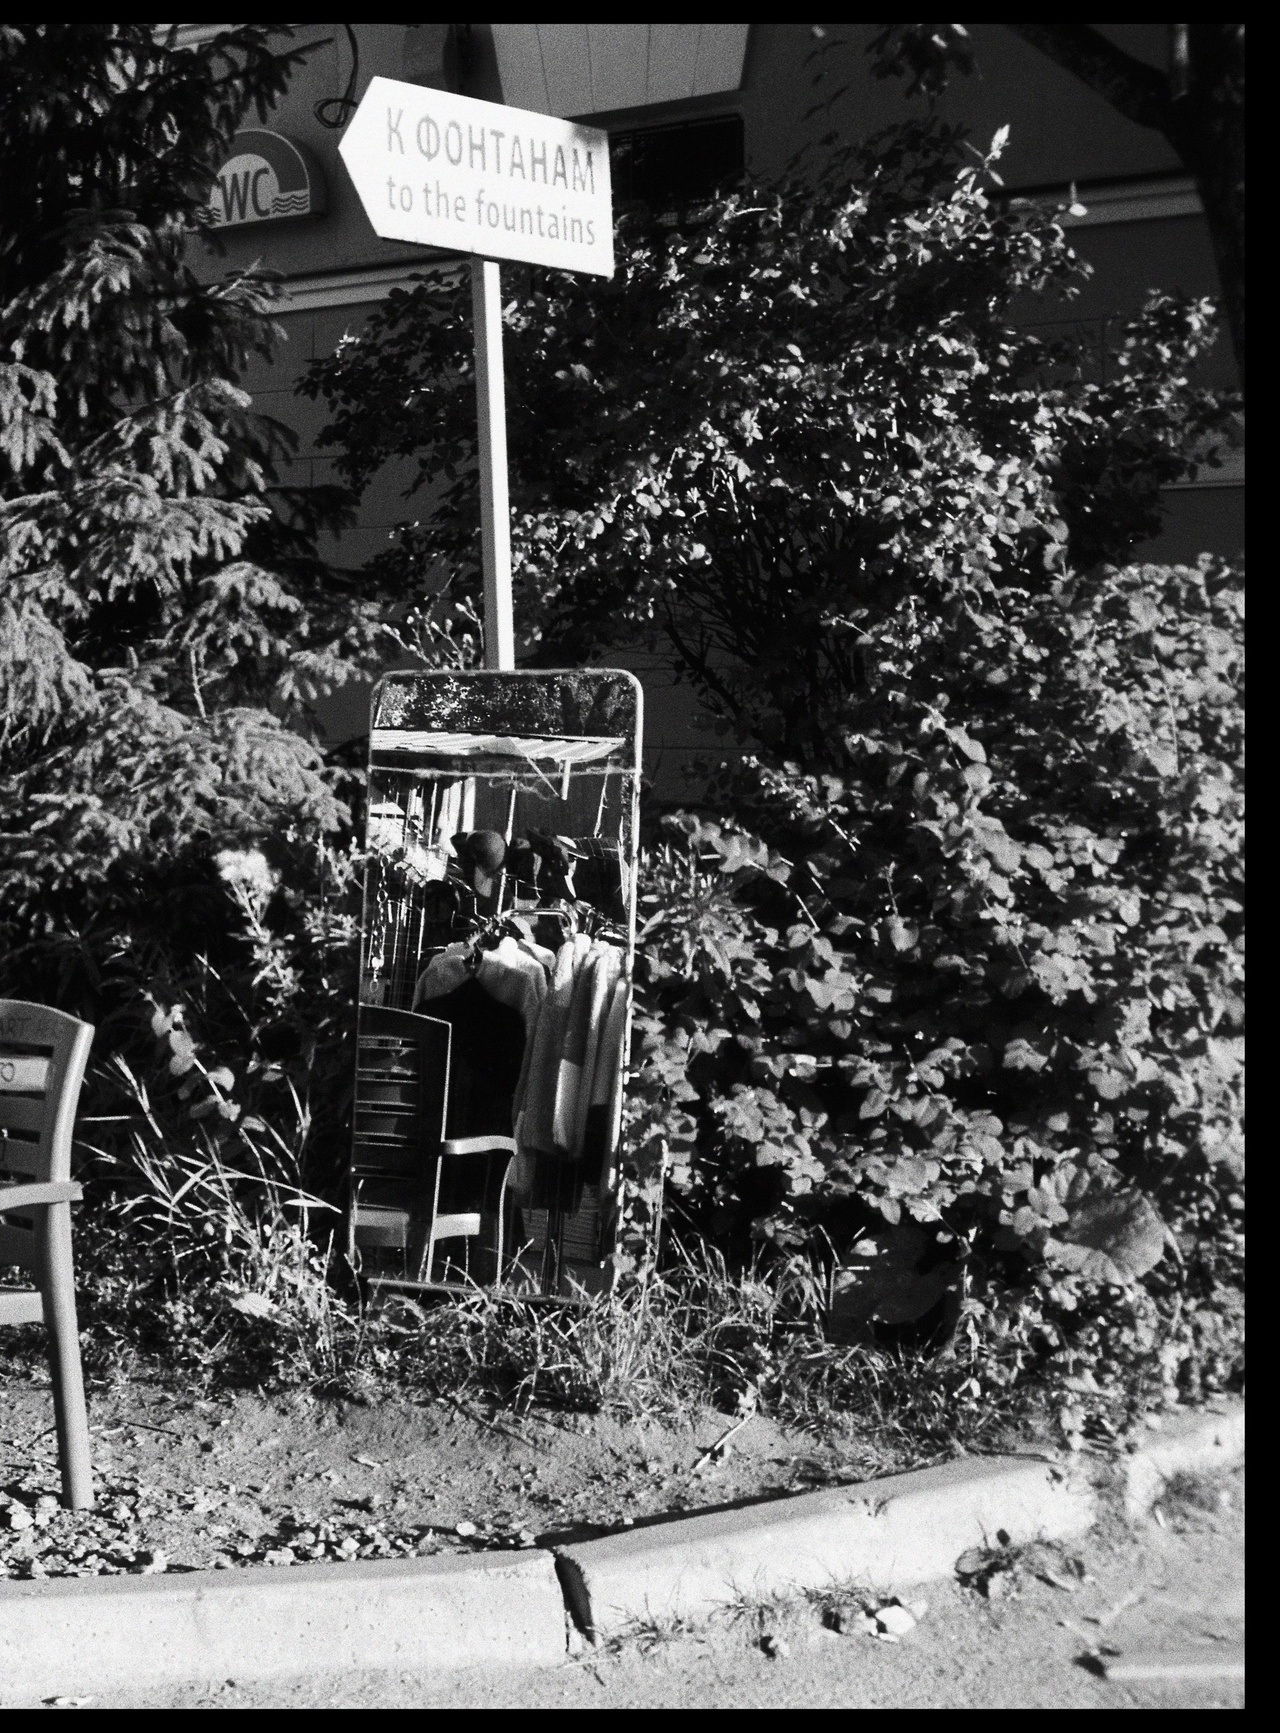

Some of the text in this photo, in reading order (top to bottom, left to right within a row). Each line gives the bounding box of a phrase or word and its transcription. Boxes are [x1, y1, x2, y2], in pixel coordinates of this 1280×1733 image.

[387, 107, 597, 196] К ФОНТАНАМ
[220, 168, 270, 222] WC
[387, 177, 597, 245] to the fountains
